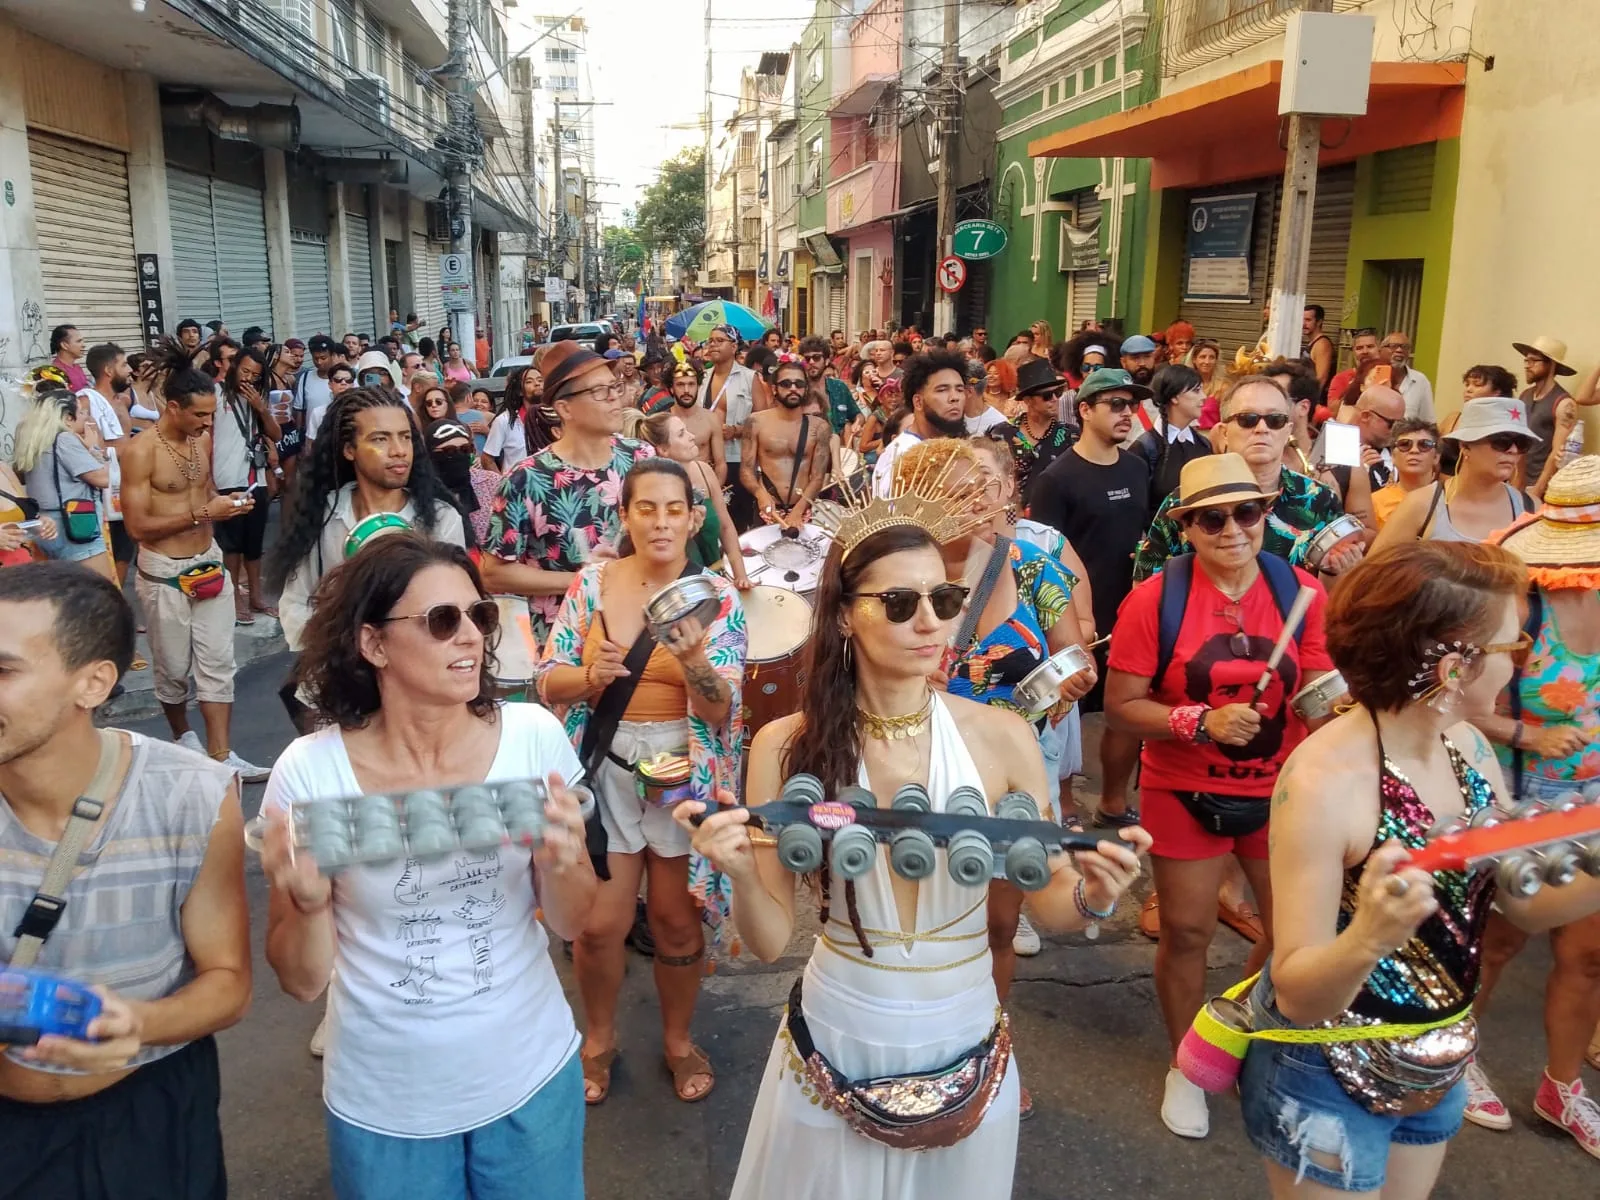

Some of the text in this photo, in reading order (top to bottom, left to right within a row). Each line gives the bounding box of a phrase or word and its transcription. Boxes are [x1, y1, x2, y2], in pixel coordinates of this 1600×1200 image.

[970, 230, 985, 250] 7
[449, 259, 457, 270] E
[417, 892, 429, 901] CAT
